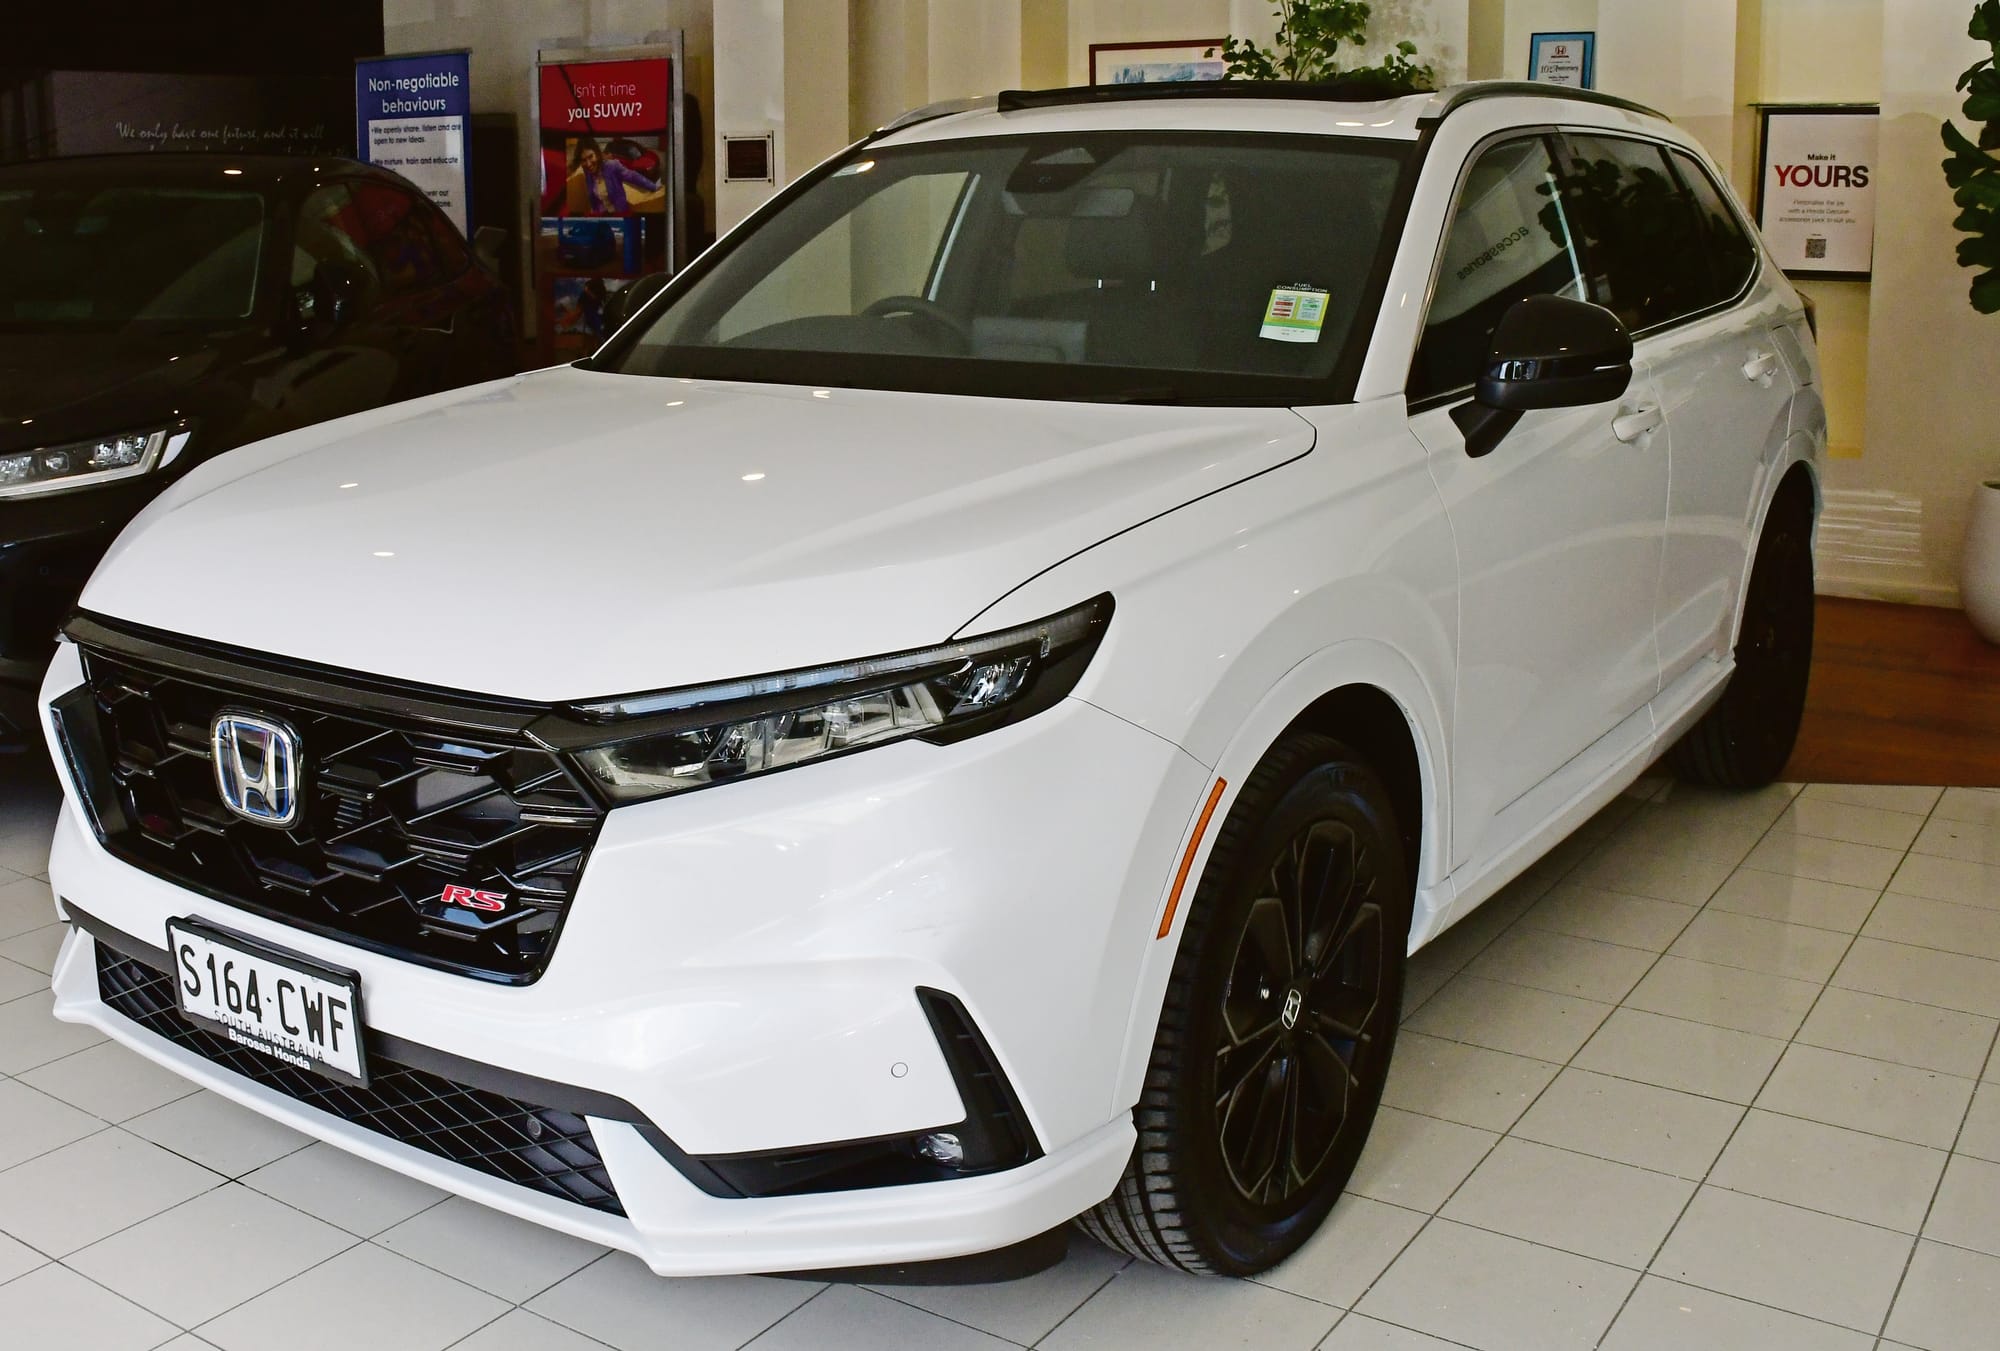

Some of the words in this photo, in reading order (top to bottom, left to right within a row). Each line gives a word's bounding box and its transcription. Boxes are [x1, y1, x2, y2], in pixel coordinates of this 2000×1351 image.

[368, 72, 459, 93] Non-negotiable
[573, 83, 596, 98] Isn't
[599, 82, 606, 97] it
[610, 82, 637, 97] time
[382, 96, 446, 113] behaviours
[568, 107, 590, 123] you
[593, 102, 643, 118] SUVW?
[139, 123, 168, 144] only
[171, 122, 197, 139] have
[200, 128, 219, 139] one
[263, 124, 286, 140] and
[1830, 153, 1836, 161] it
[1774, 164, 1869, 188] YOURS
[1276, 285, 1328, 293] CONSUMPTION
[440, 883, 509, 912] RS
[214, 1010, 252, 1035] SOUTH
[258, 1027, 325, 1063] AUSTRALIA
[228, 1027, 273, 1056] Barossa
[273, 1044, 312, 1071] Honda
